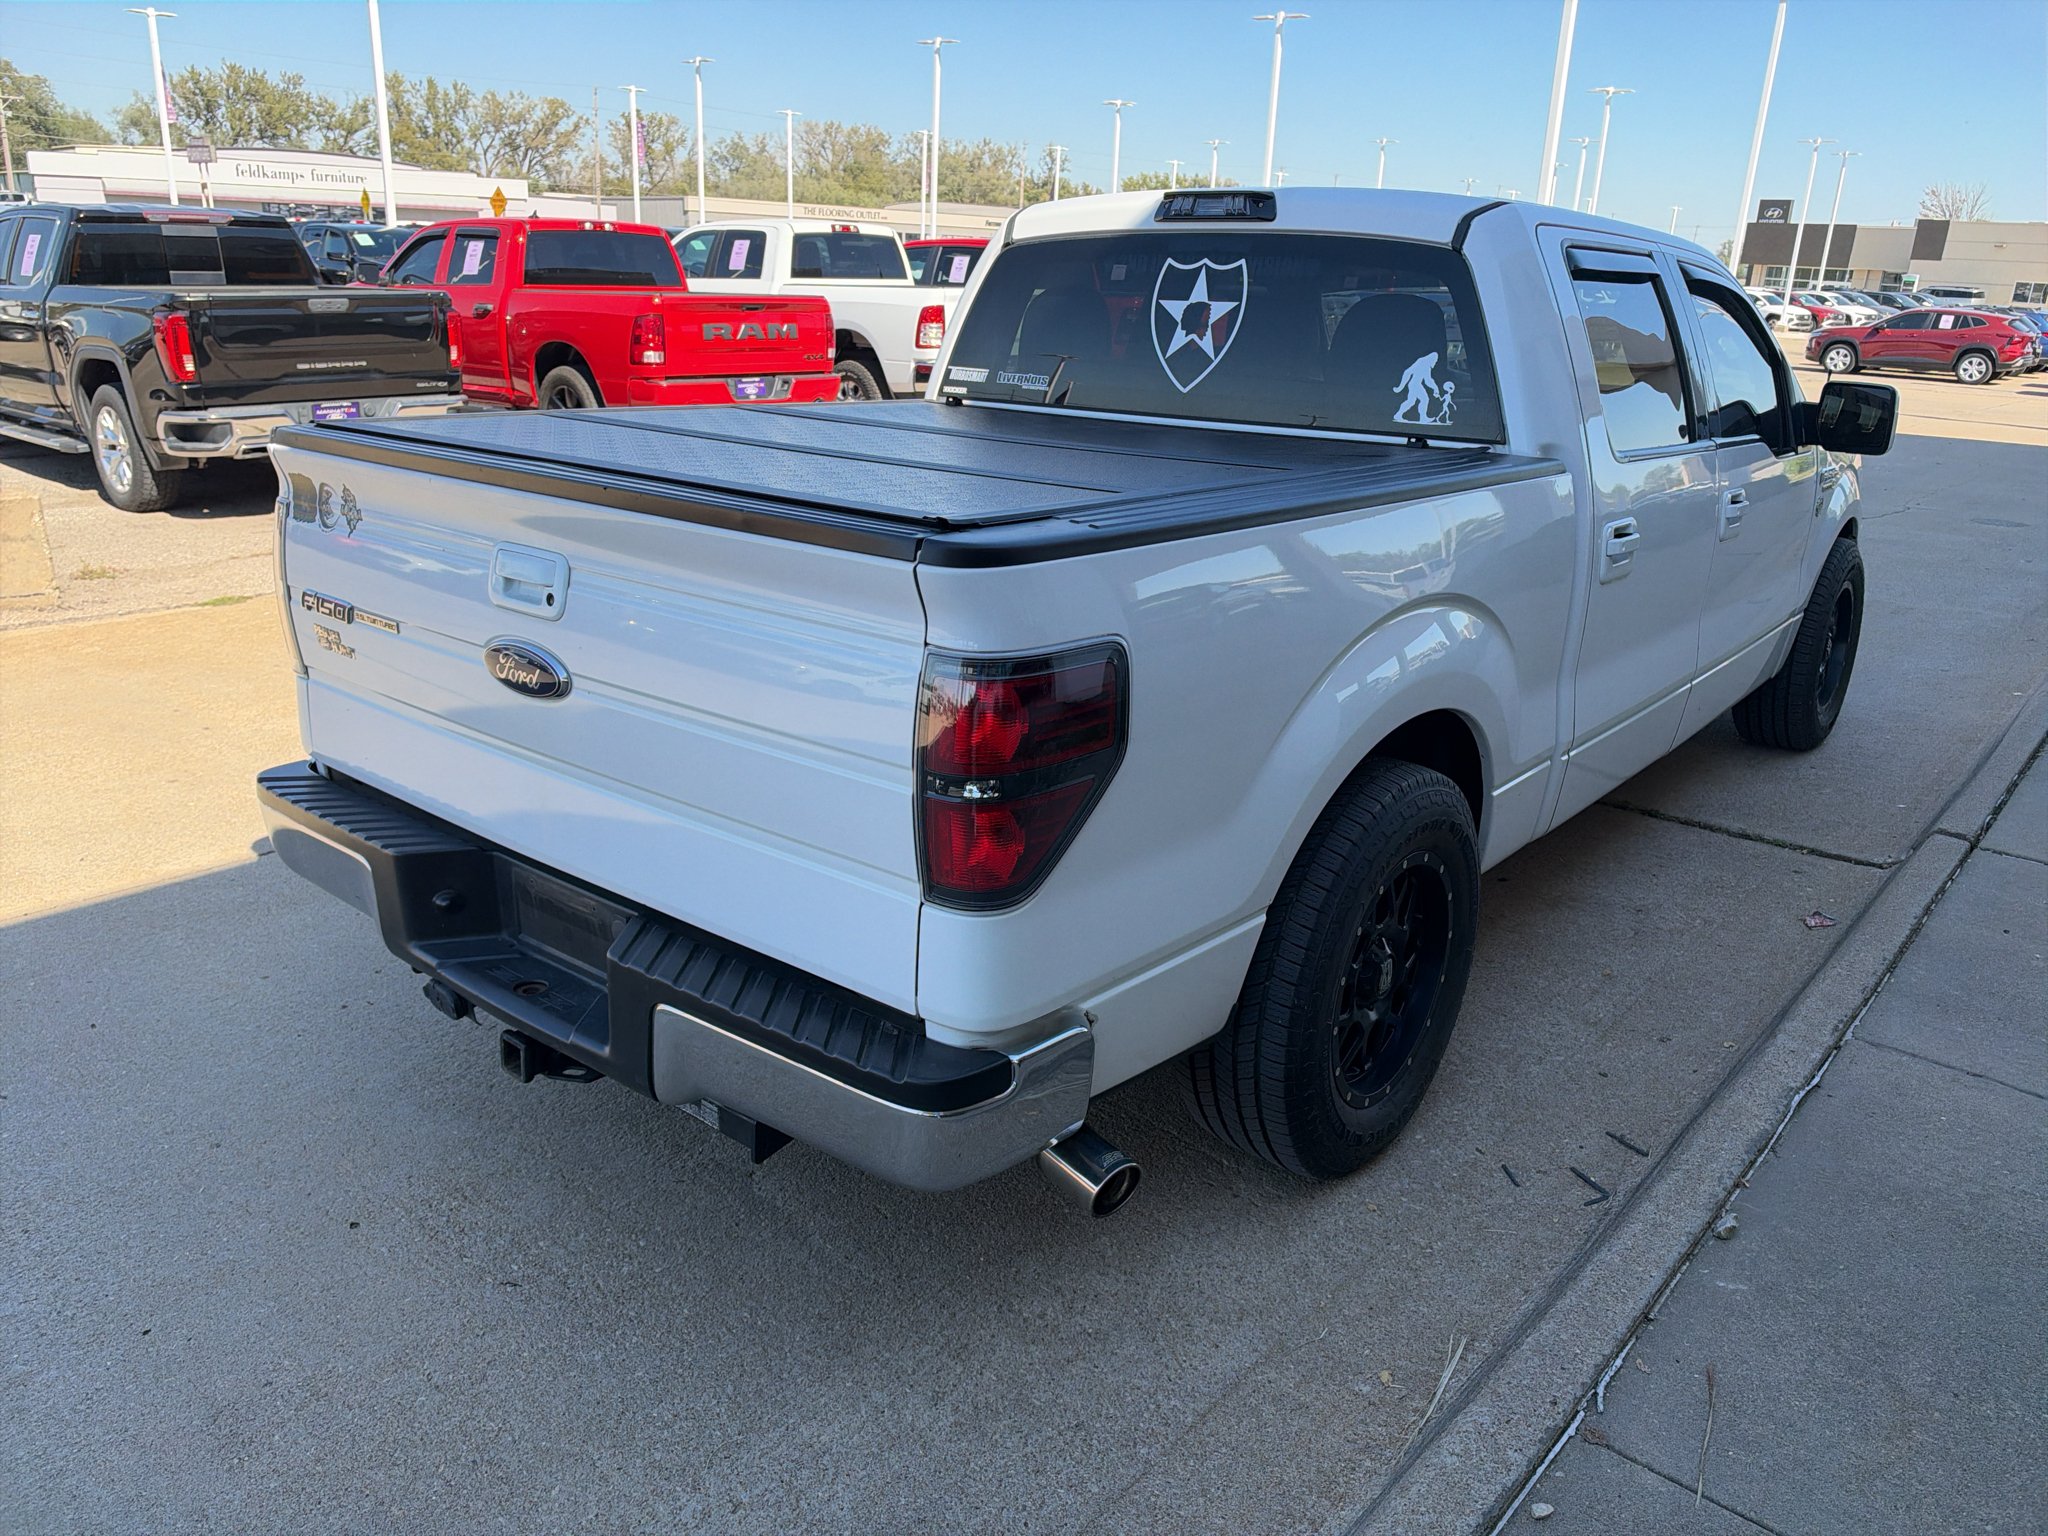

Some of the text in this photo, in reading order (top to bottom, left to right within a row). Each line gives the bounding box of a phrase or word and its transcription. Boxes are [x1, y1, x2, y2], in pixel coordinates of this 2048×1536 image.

[235, 164, 367, 184] feldkamps furniture
[803, 206, 880, 220] THE FLOORING OUTLET
[702, 323, 798, 340] RAM
[496, 651, 540, 689] Ford
